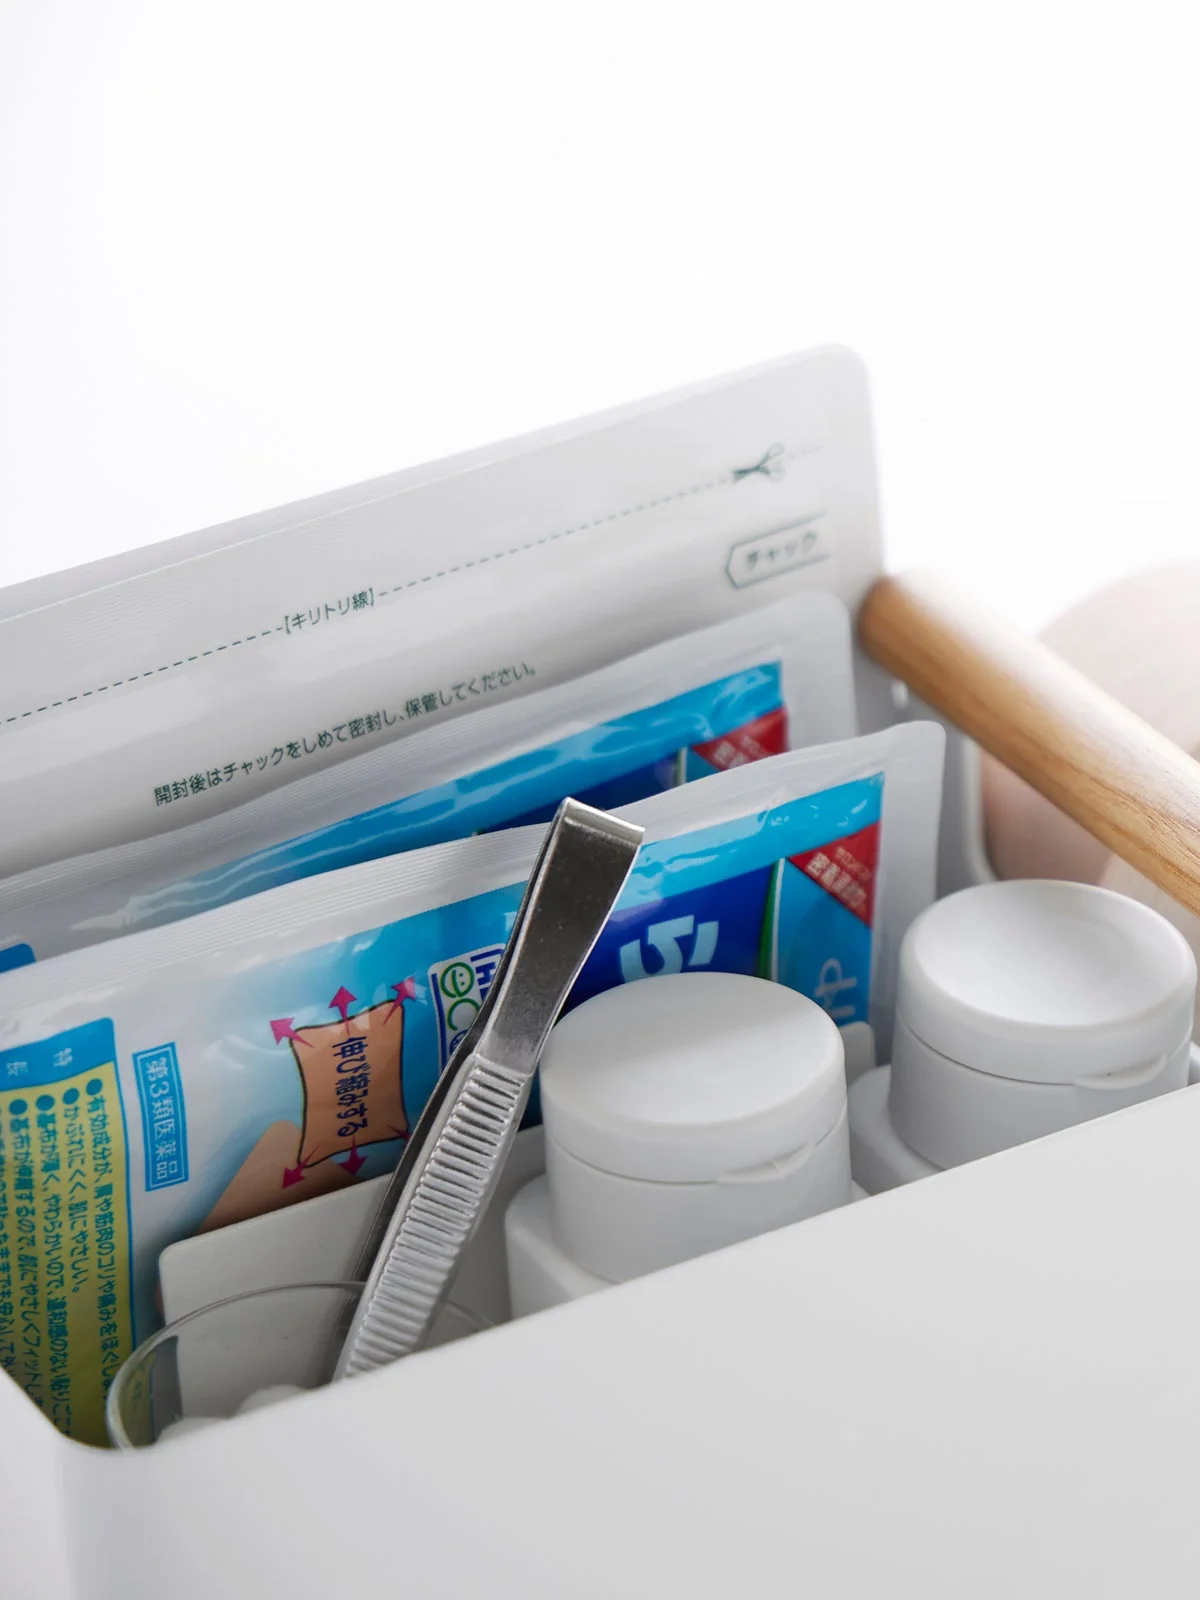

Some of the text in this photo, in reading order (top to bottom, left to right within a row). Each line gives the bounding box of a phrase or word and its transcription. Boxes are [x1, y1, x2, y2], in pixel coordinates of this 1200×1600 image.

[154, 661, 536, 807] 開封後はチャックをしめて密封し、保管してください。
[145, 1056, 179, 1180] 第3類医薬品
[331, 1035, 371, 1138] 伸び縮みする
